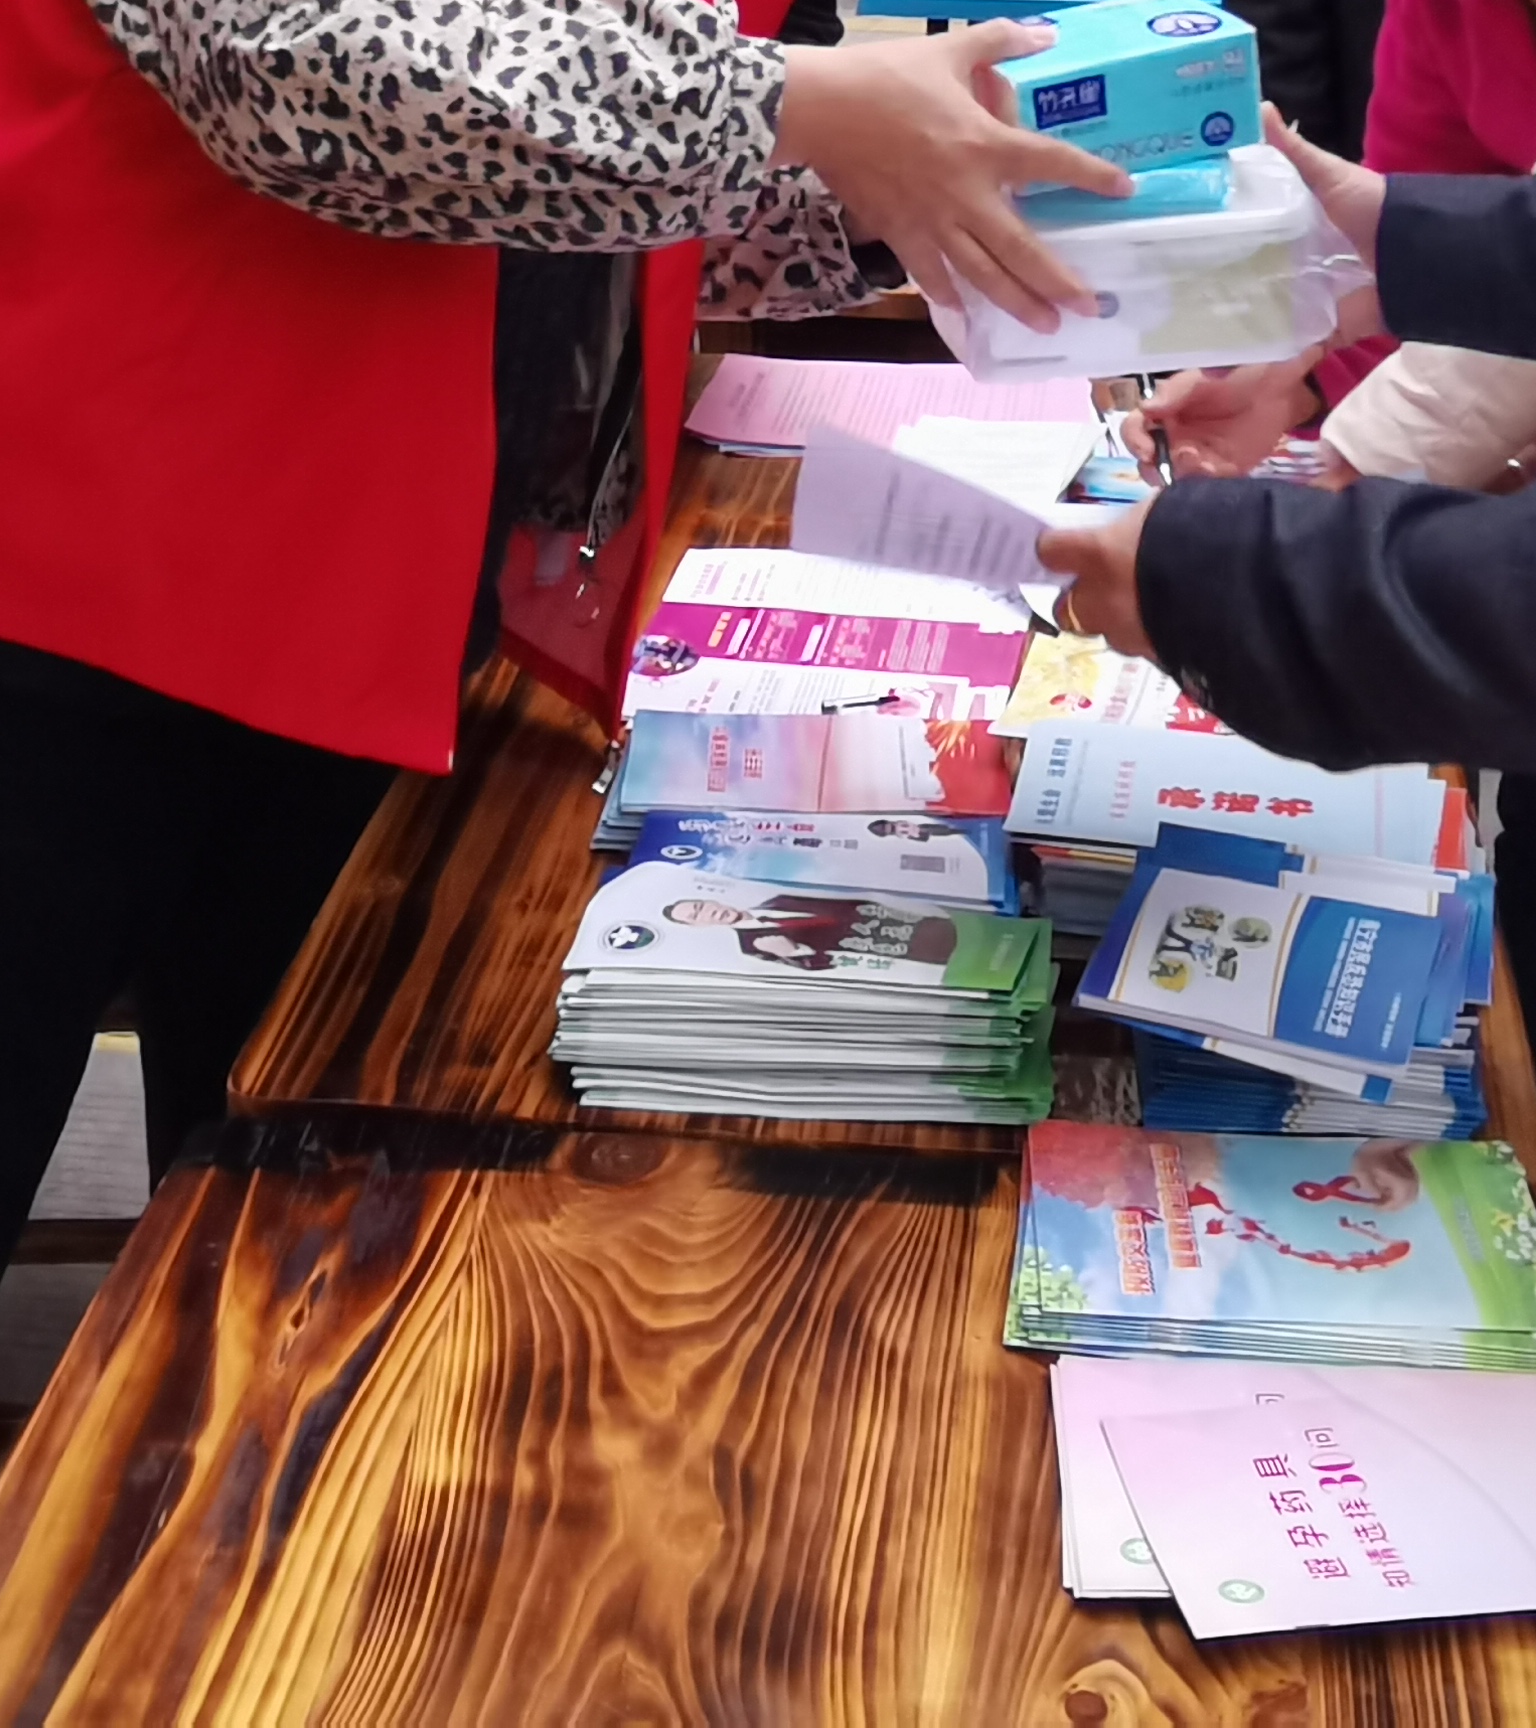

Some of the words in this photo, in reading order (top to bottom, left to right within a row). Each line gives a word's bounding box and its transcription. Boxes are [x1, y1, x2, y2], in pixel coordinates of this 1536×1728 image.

[1253, 1453, 1351, 1578] 避孕药具
[1304, 1426, 1416, 1588] 知情选择30问
